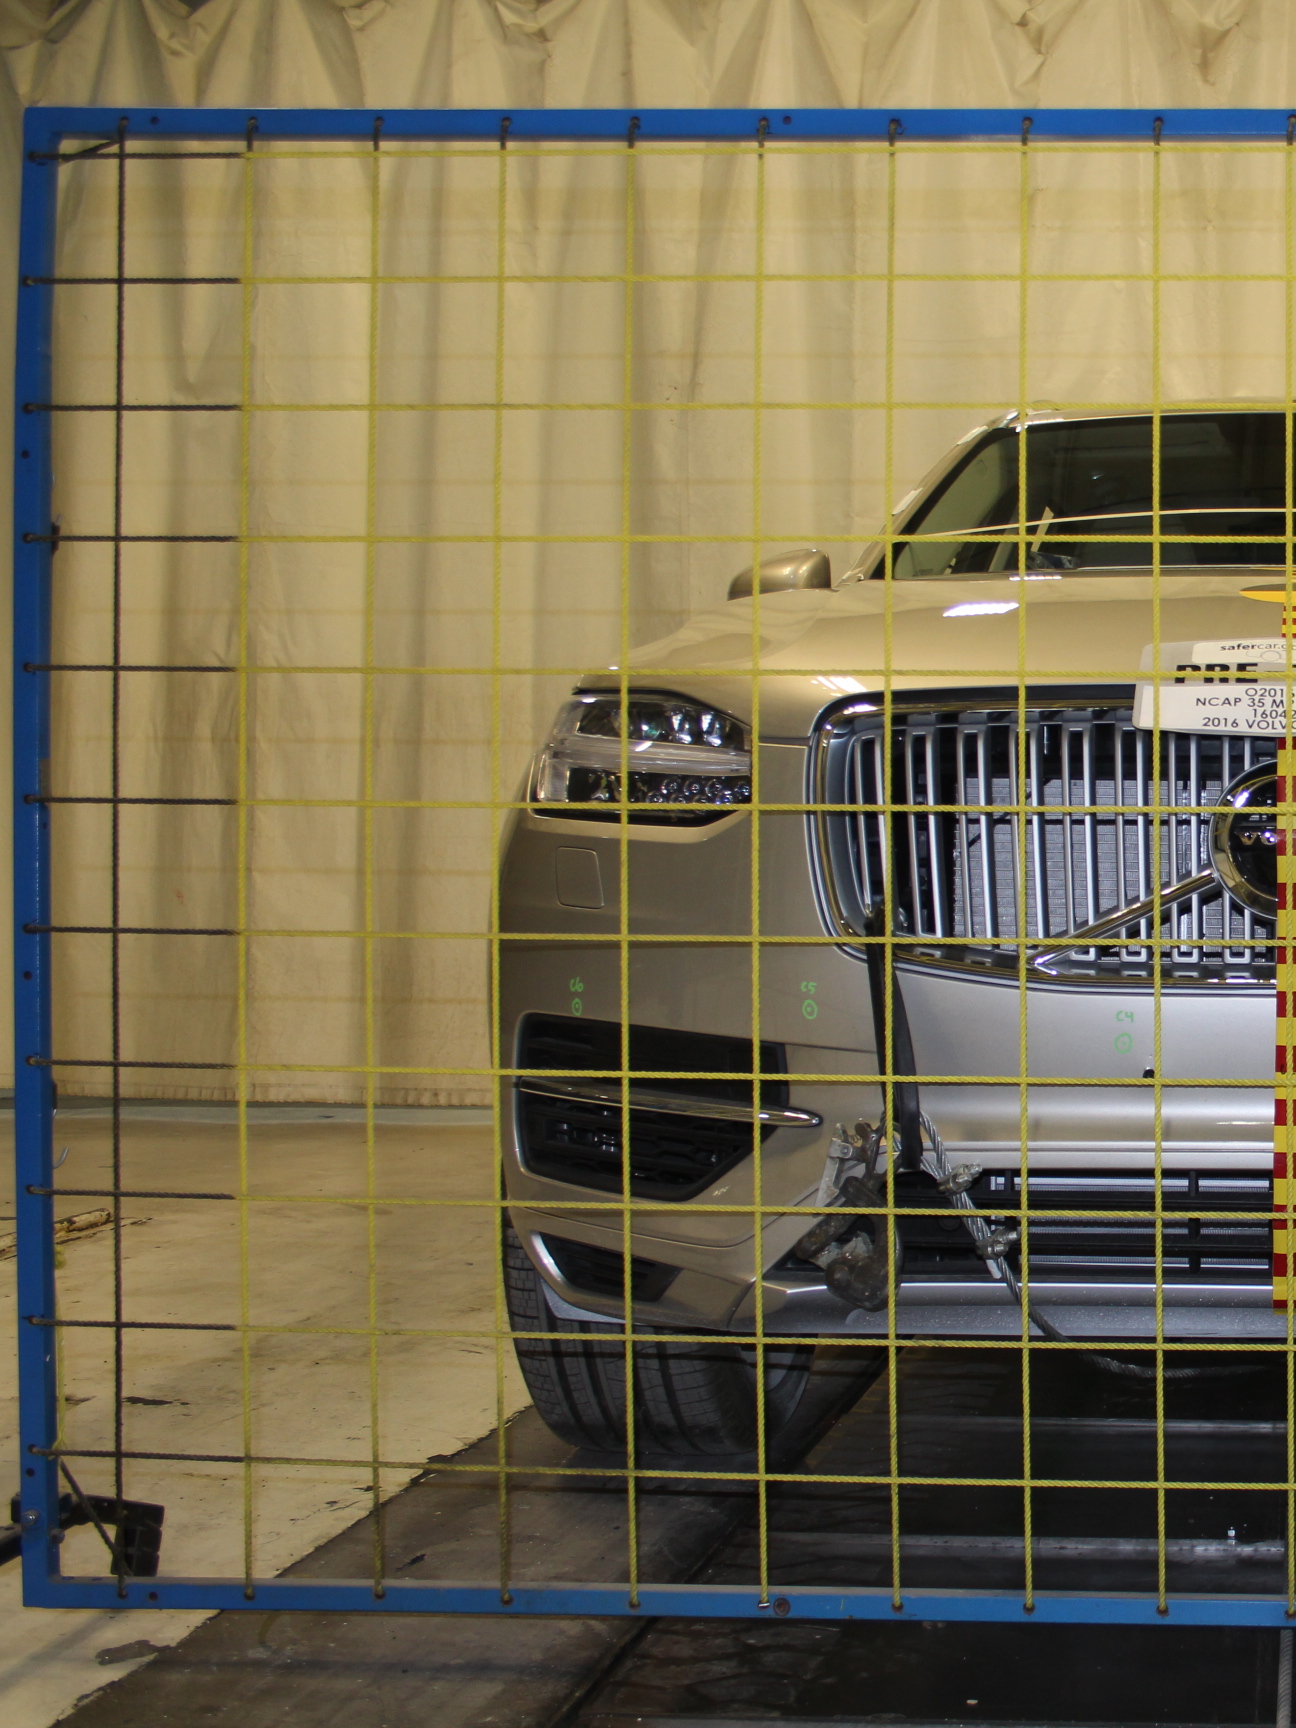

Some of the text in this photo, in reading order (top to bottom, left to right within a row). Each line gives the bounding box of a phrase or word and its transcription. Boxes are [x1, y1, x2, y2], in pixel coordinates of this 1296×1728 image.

[1195, 697, 1242, 707] NCAP
[1246, 698, 1265, 708] 35
[1201, 717, 1239, 728] 2016
[1115, 1011, 1134, 1023] C4
